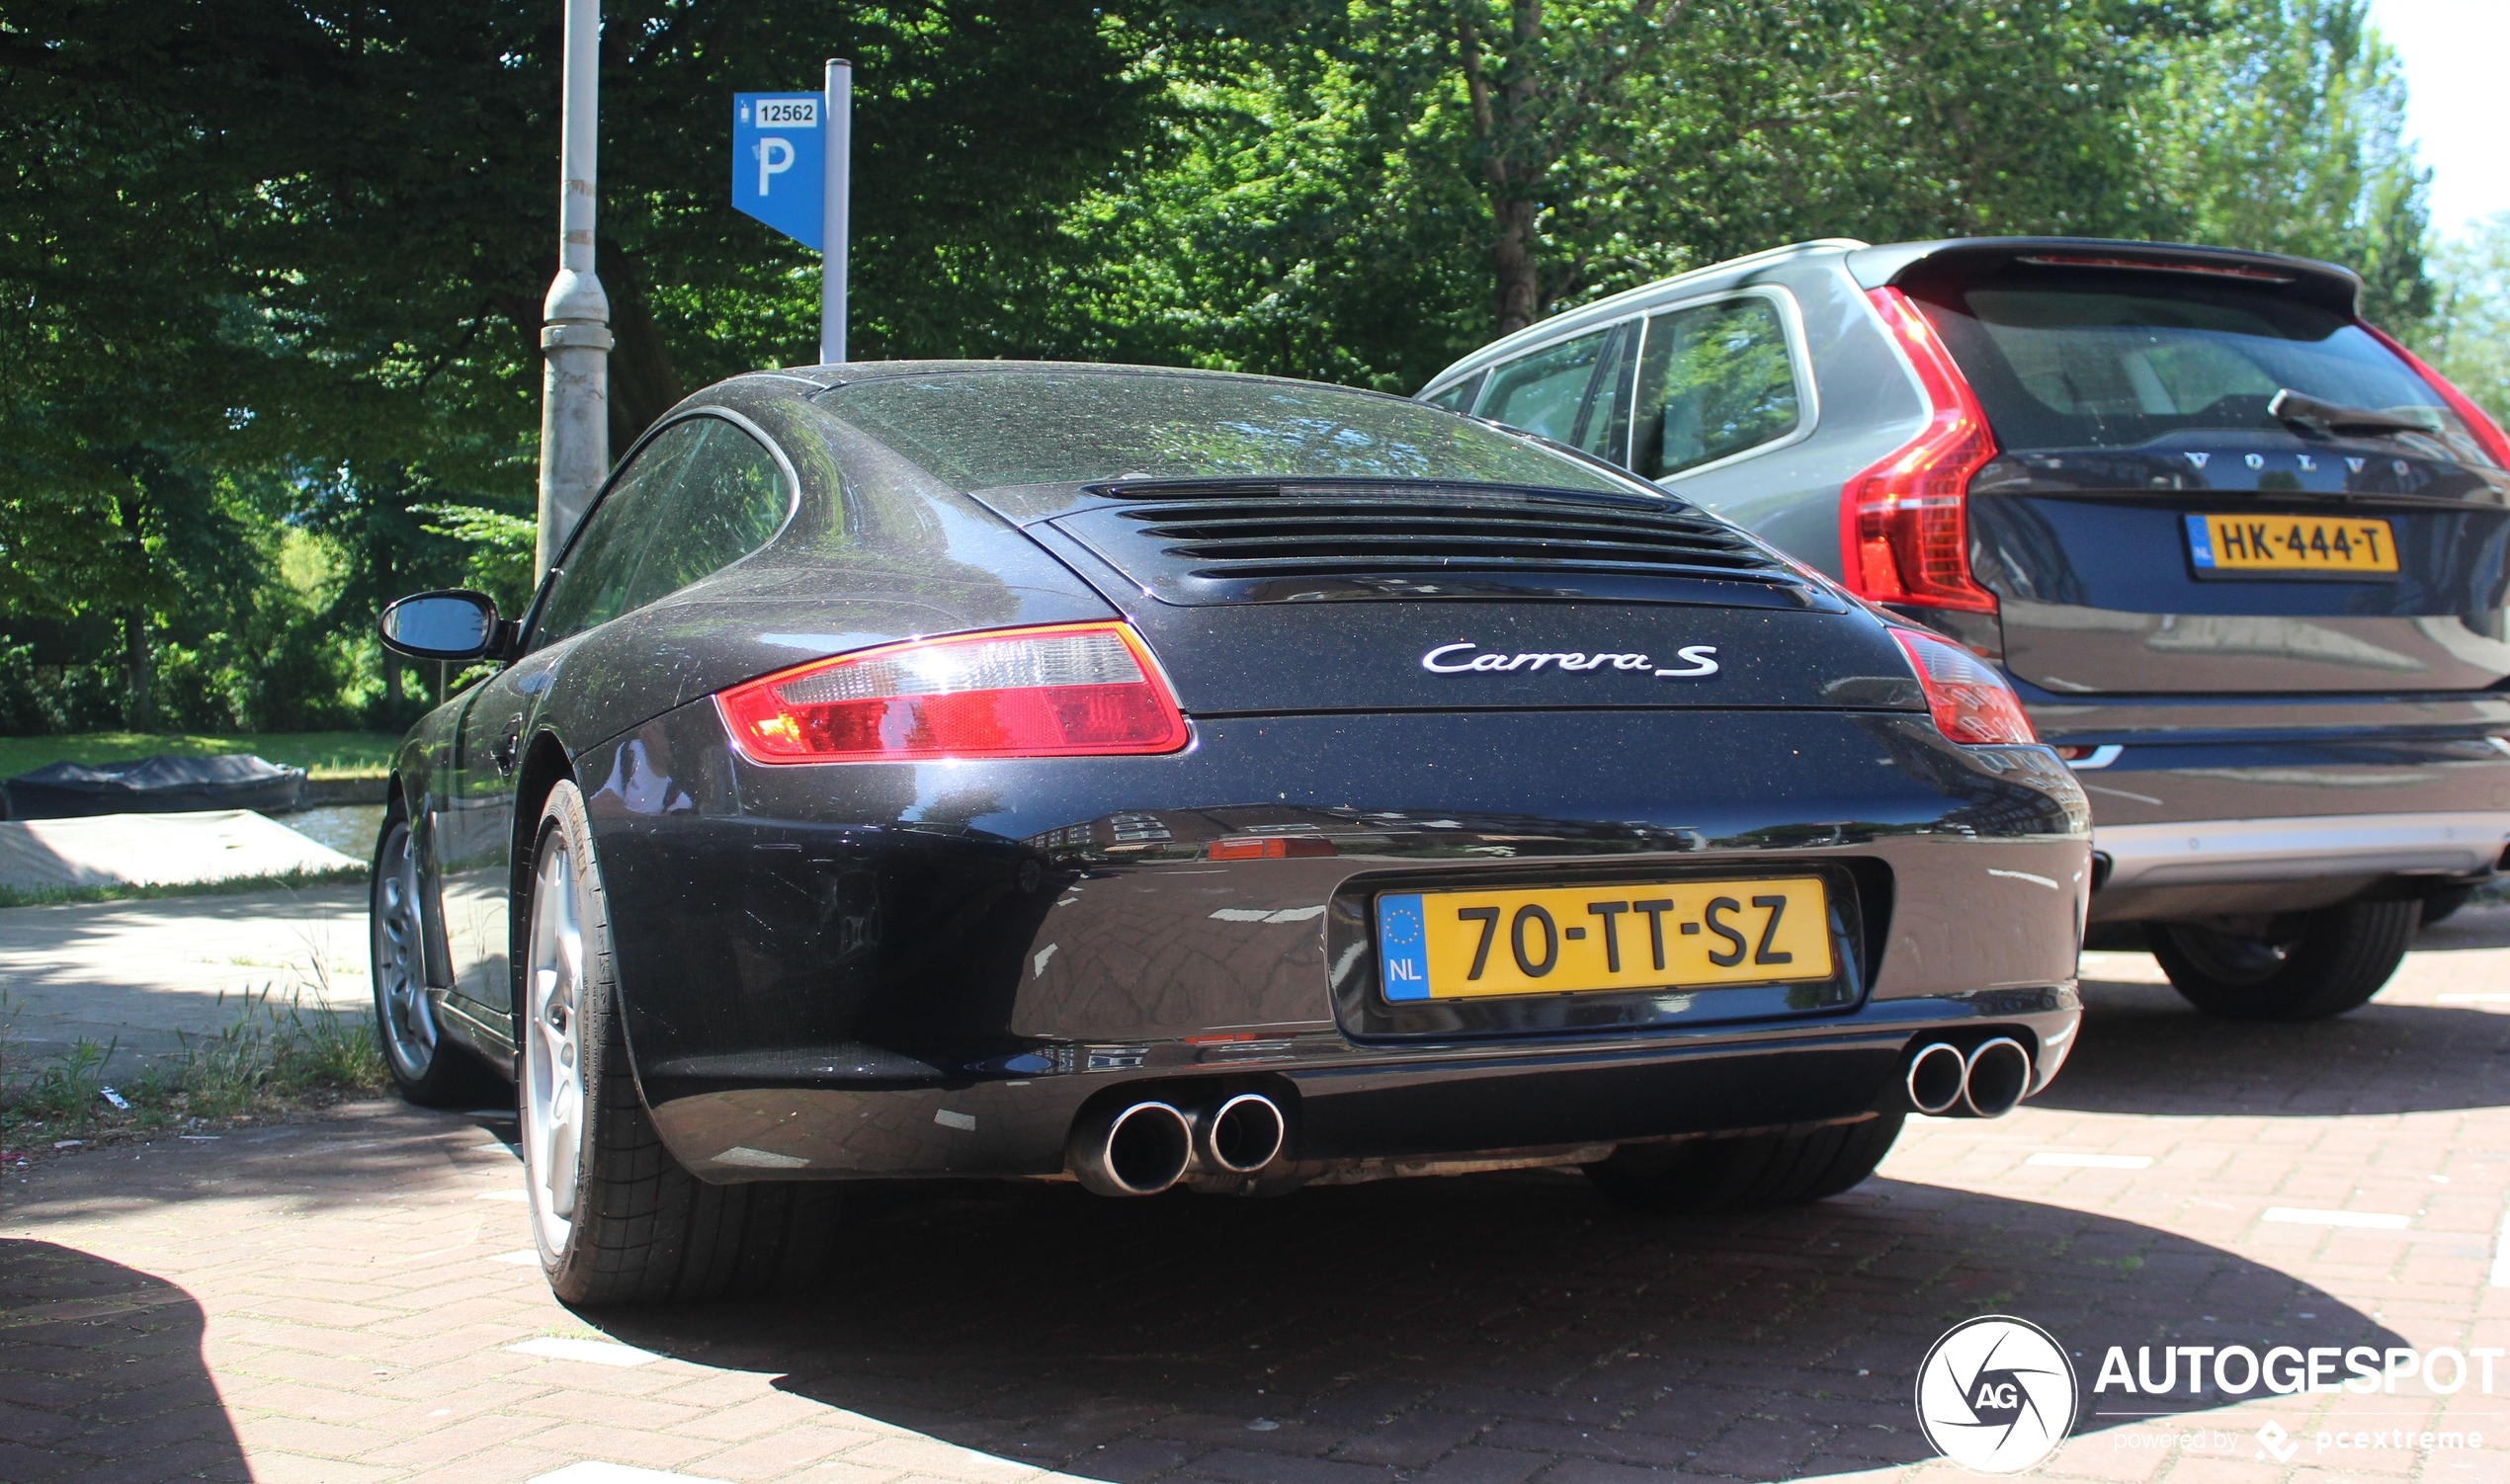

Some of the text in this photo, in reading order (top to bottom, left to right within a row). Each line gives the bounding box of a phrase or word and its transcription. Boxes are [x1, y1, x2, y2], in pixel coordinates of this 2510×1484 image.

[760, 105, 813, 122] 12562
[759, 136, 795, 196] P
[2184, 452, 2410, 477] VOLVO
[2195, 544, 2213, 560] NL
[2219, 523, 2380, 563] HK-444-T
[1421, 642, 1719, 677] Carrera S
[1458, 895, 1794, 981] 70-TT-SZ
[1389, 957, 1422, 982] NL
